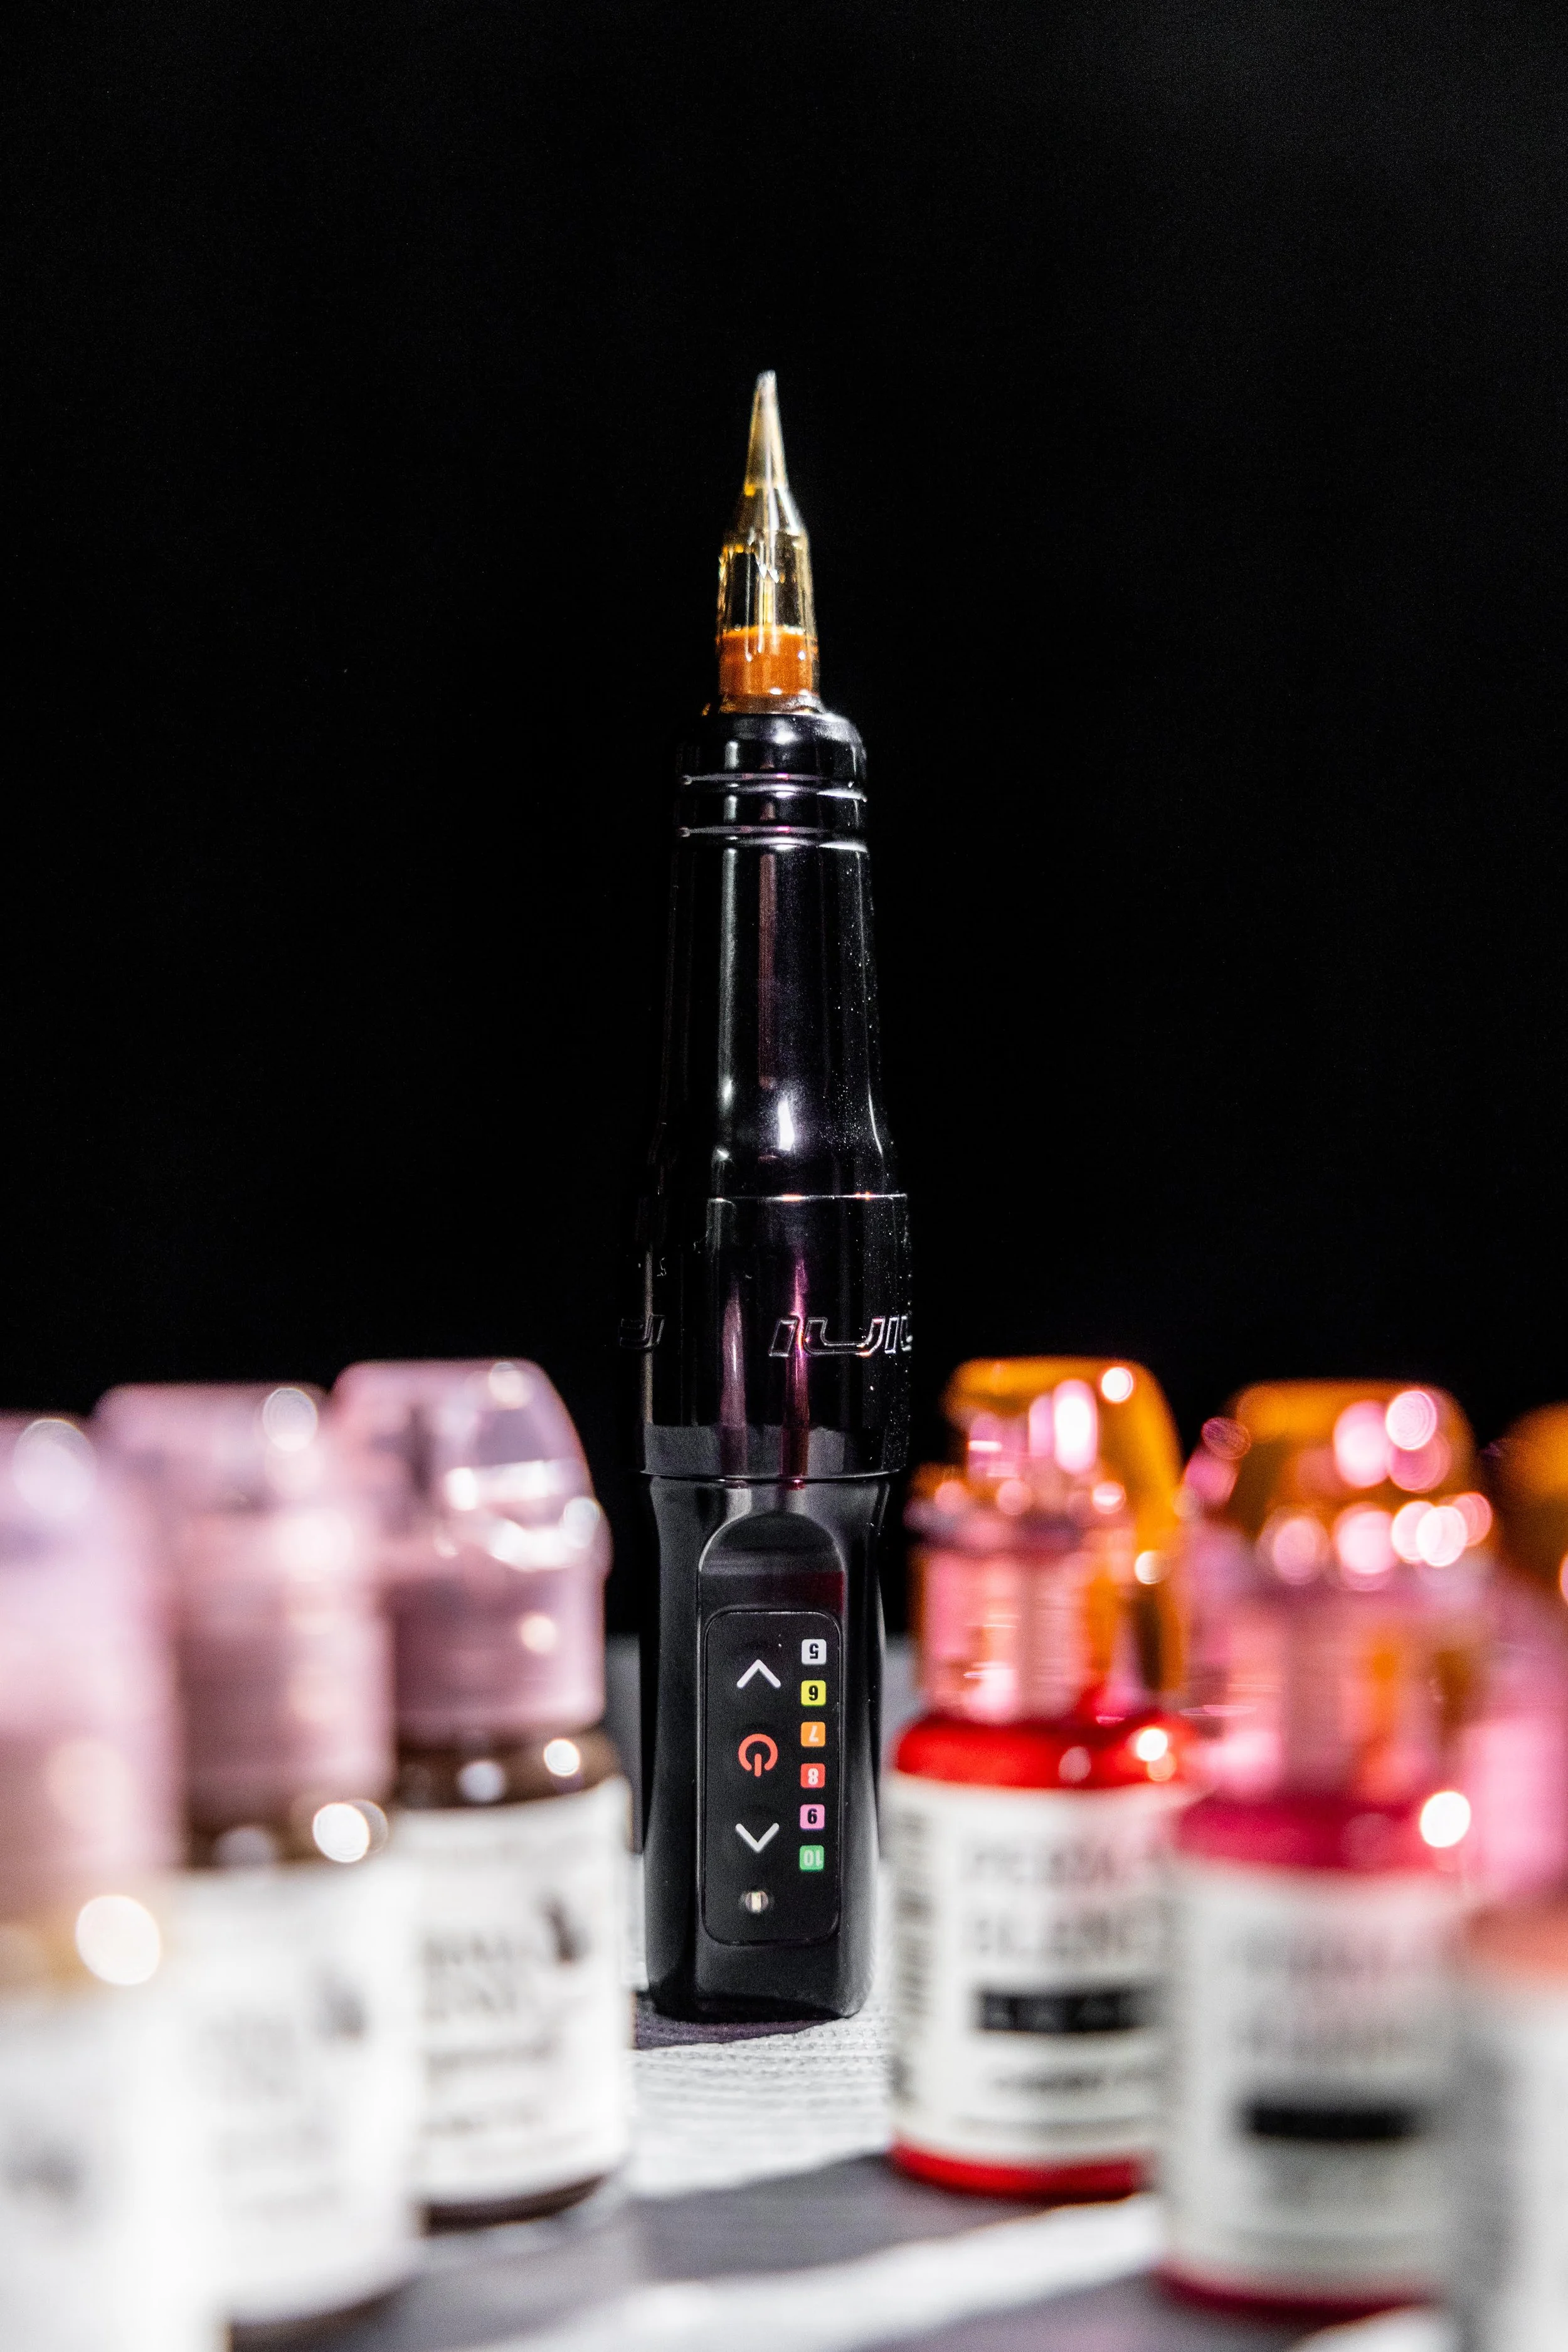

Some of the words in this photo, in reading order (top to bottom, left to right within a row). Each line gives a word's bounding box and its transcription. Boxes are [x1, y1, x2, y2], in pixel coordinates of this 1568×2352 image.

[809, 1643, 819, 1660] 5
[808, 1685, 818, 1701] 6
[808, 1725, 819, 1743] 7
[808, 1767, 819, 1786] 8
[807, 1808, 818, 1825] 9
[803, 1848, 822, 1867] 10
